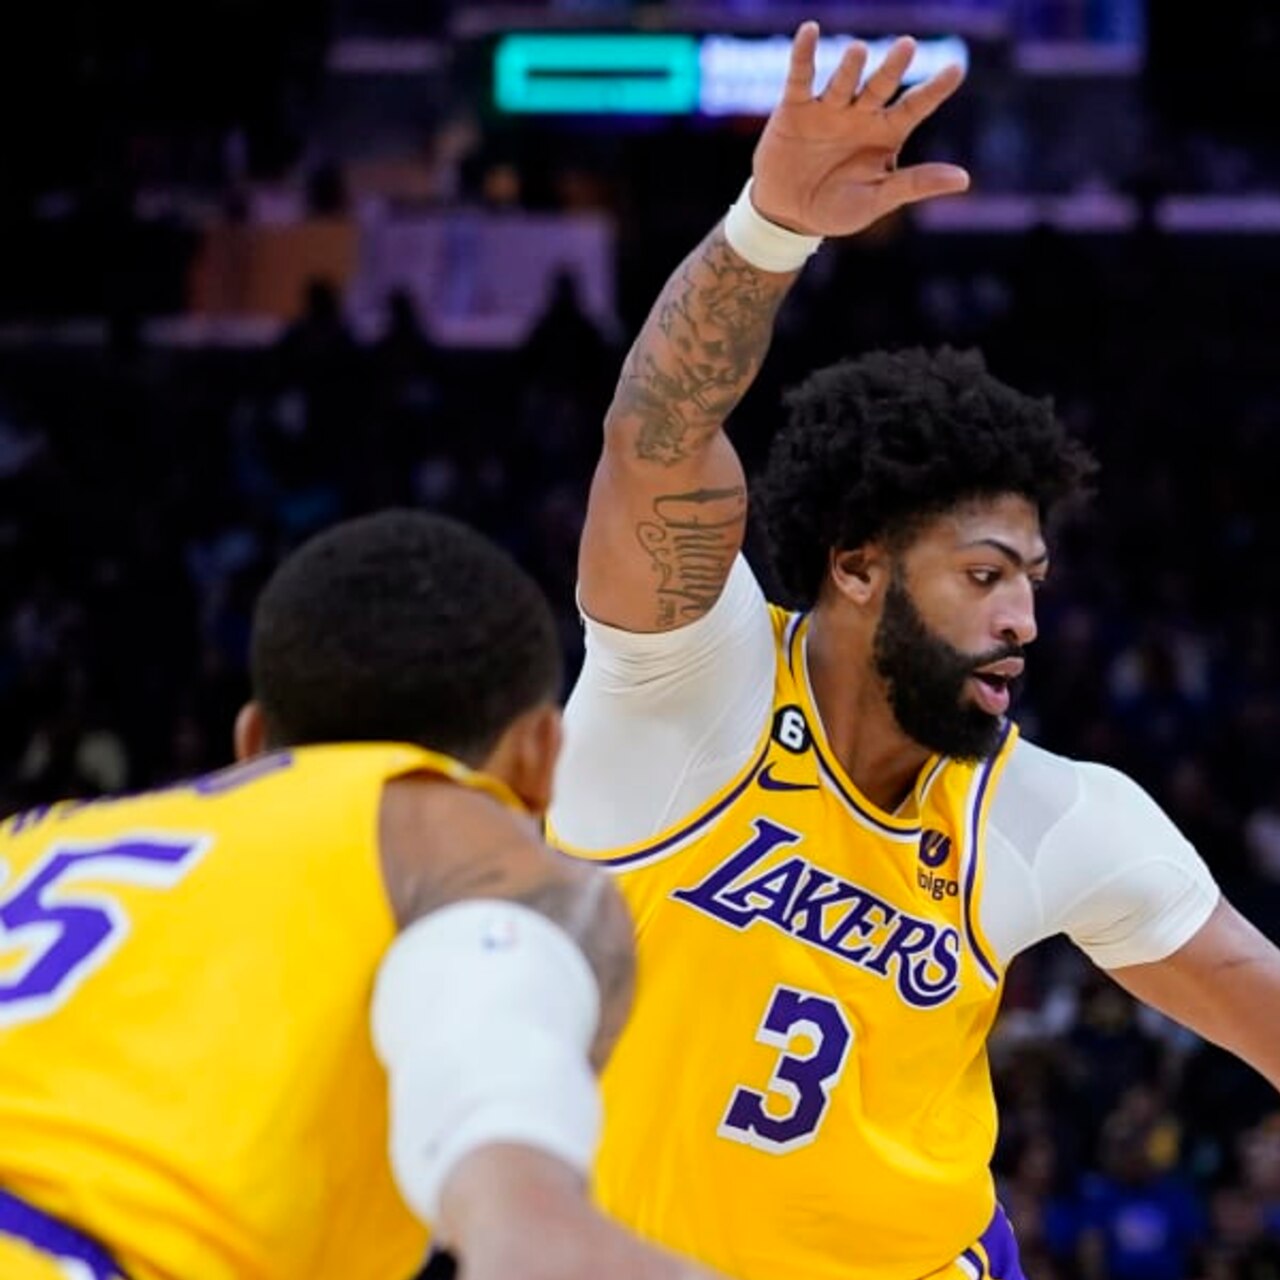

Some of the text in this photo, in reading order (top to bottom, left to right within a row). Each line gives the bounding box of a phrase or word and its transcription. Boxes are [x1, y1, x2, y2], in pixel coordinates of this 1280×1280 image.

[780, 708, 806, 750] 6
[667, 817, 961, 1008] LAKERS
[717, 984, 856, 1156] 3
